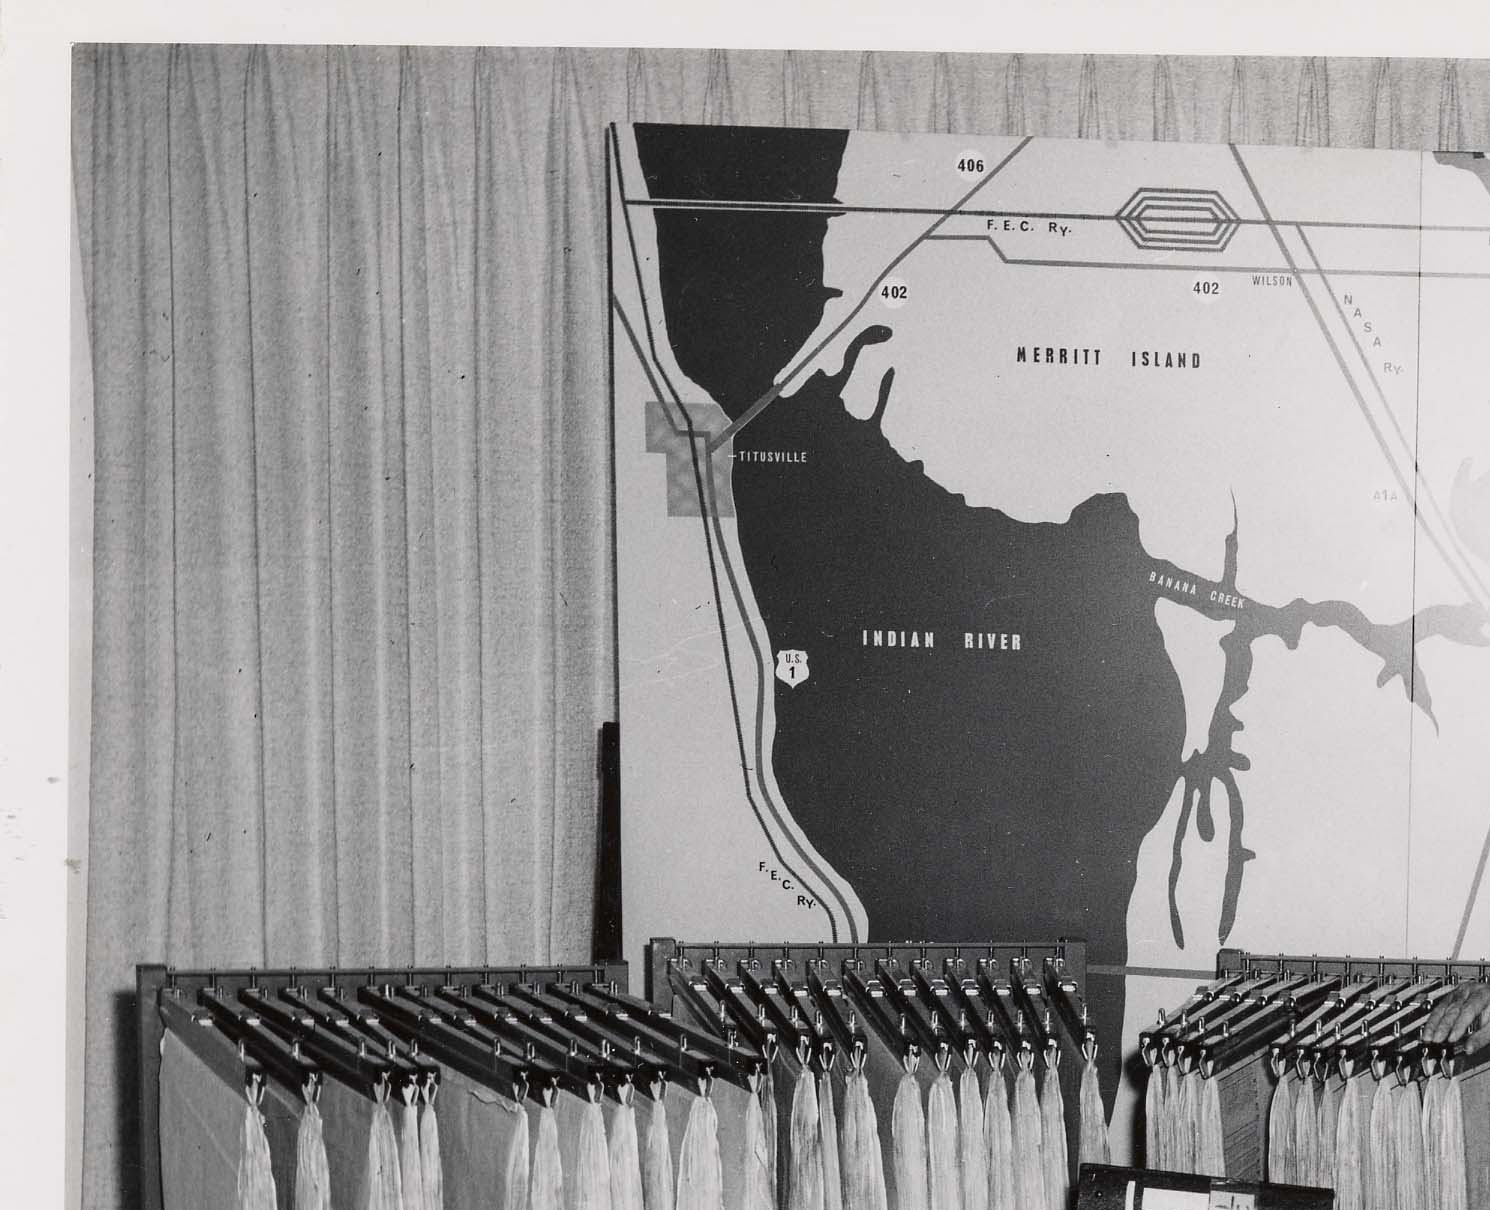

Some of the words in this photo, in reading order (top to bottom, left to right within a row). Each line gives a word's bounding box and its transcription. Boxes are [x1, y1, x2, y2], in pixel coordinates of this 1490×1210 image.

[958, 159, 984, 172] 406
[1252, 275, 1292, 287] WILSON
[882, 286, 907, 299] 402
[1193, 282, 1218, 294] 402
[1344, 294, 1381, 346] NASA
[1017, 347, 1100, 365] MERRITT
[1132, 352, 1199, 368] ISLAND
[740, 451, 806, 462] TITUSVILLE
[1149, 572, 1196, 595] BANANA
[1210, 590, 1246, 610] CREEK
[863, 630, 933, 647] INDIAN
[965, 633, 1020, 650] RIVER
[789, 666, 794, 678] 1
